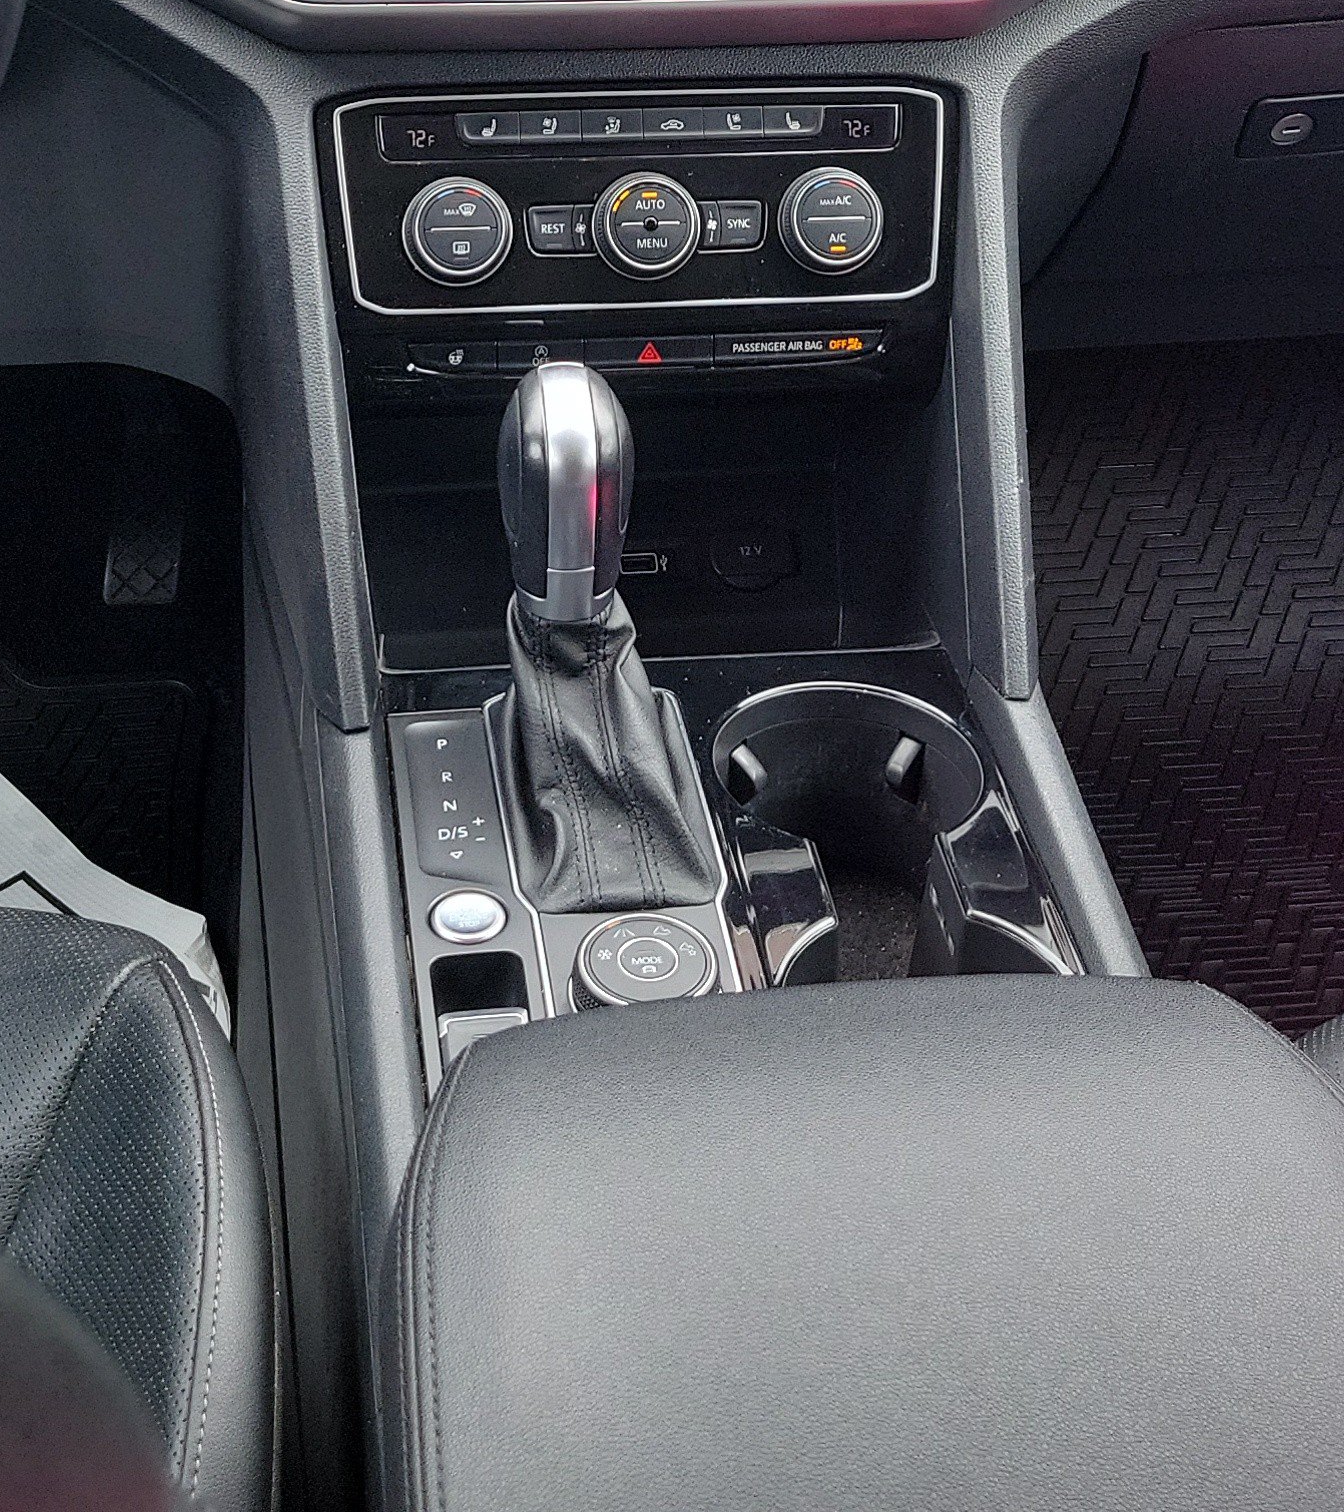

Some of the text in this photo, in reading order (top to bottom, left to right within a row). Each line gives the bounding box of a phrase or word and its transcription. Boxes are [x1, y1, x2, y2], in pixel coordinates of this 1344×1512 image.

[635, 199, 666, 211] AUTO
[835, 195, 852, 206] A/C
[444, 208, 460, 216] MAX
[541, 223, 566, 234] REST
[727, 218, 751, 229] SYNC
[636, 237, 668, 249] MENU
[829, 232, 847, 243] A/C
[732, 338, 848, 354] PASSENGER AIR BAG OFF
[437, 739, 448, 750] P
[442, 772, 453, 783] R
[443, 800, 458, 812] N
[438, 826, 469, 841] D/S
[631, 956, 663, 965] MODE
